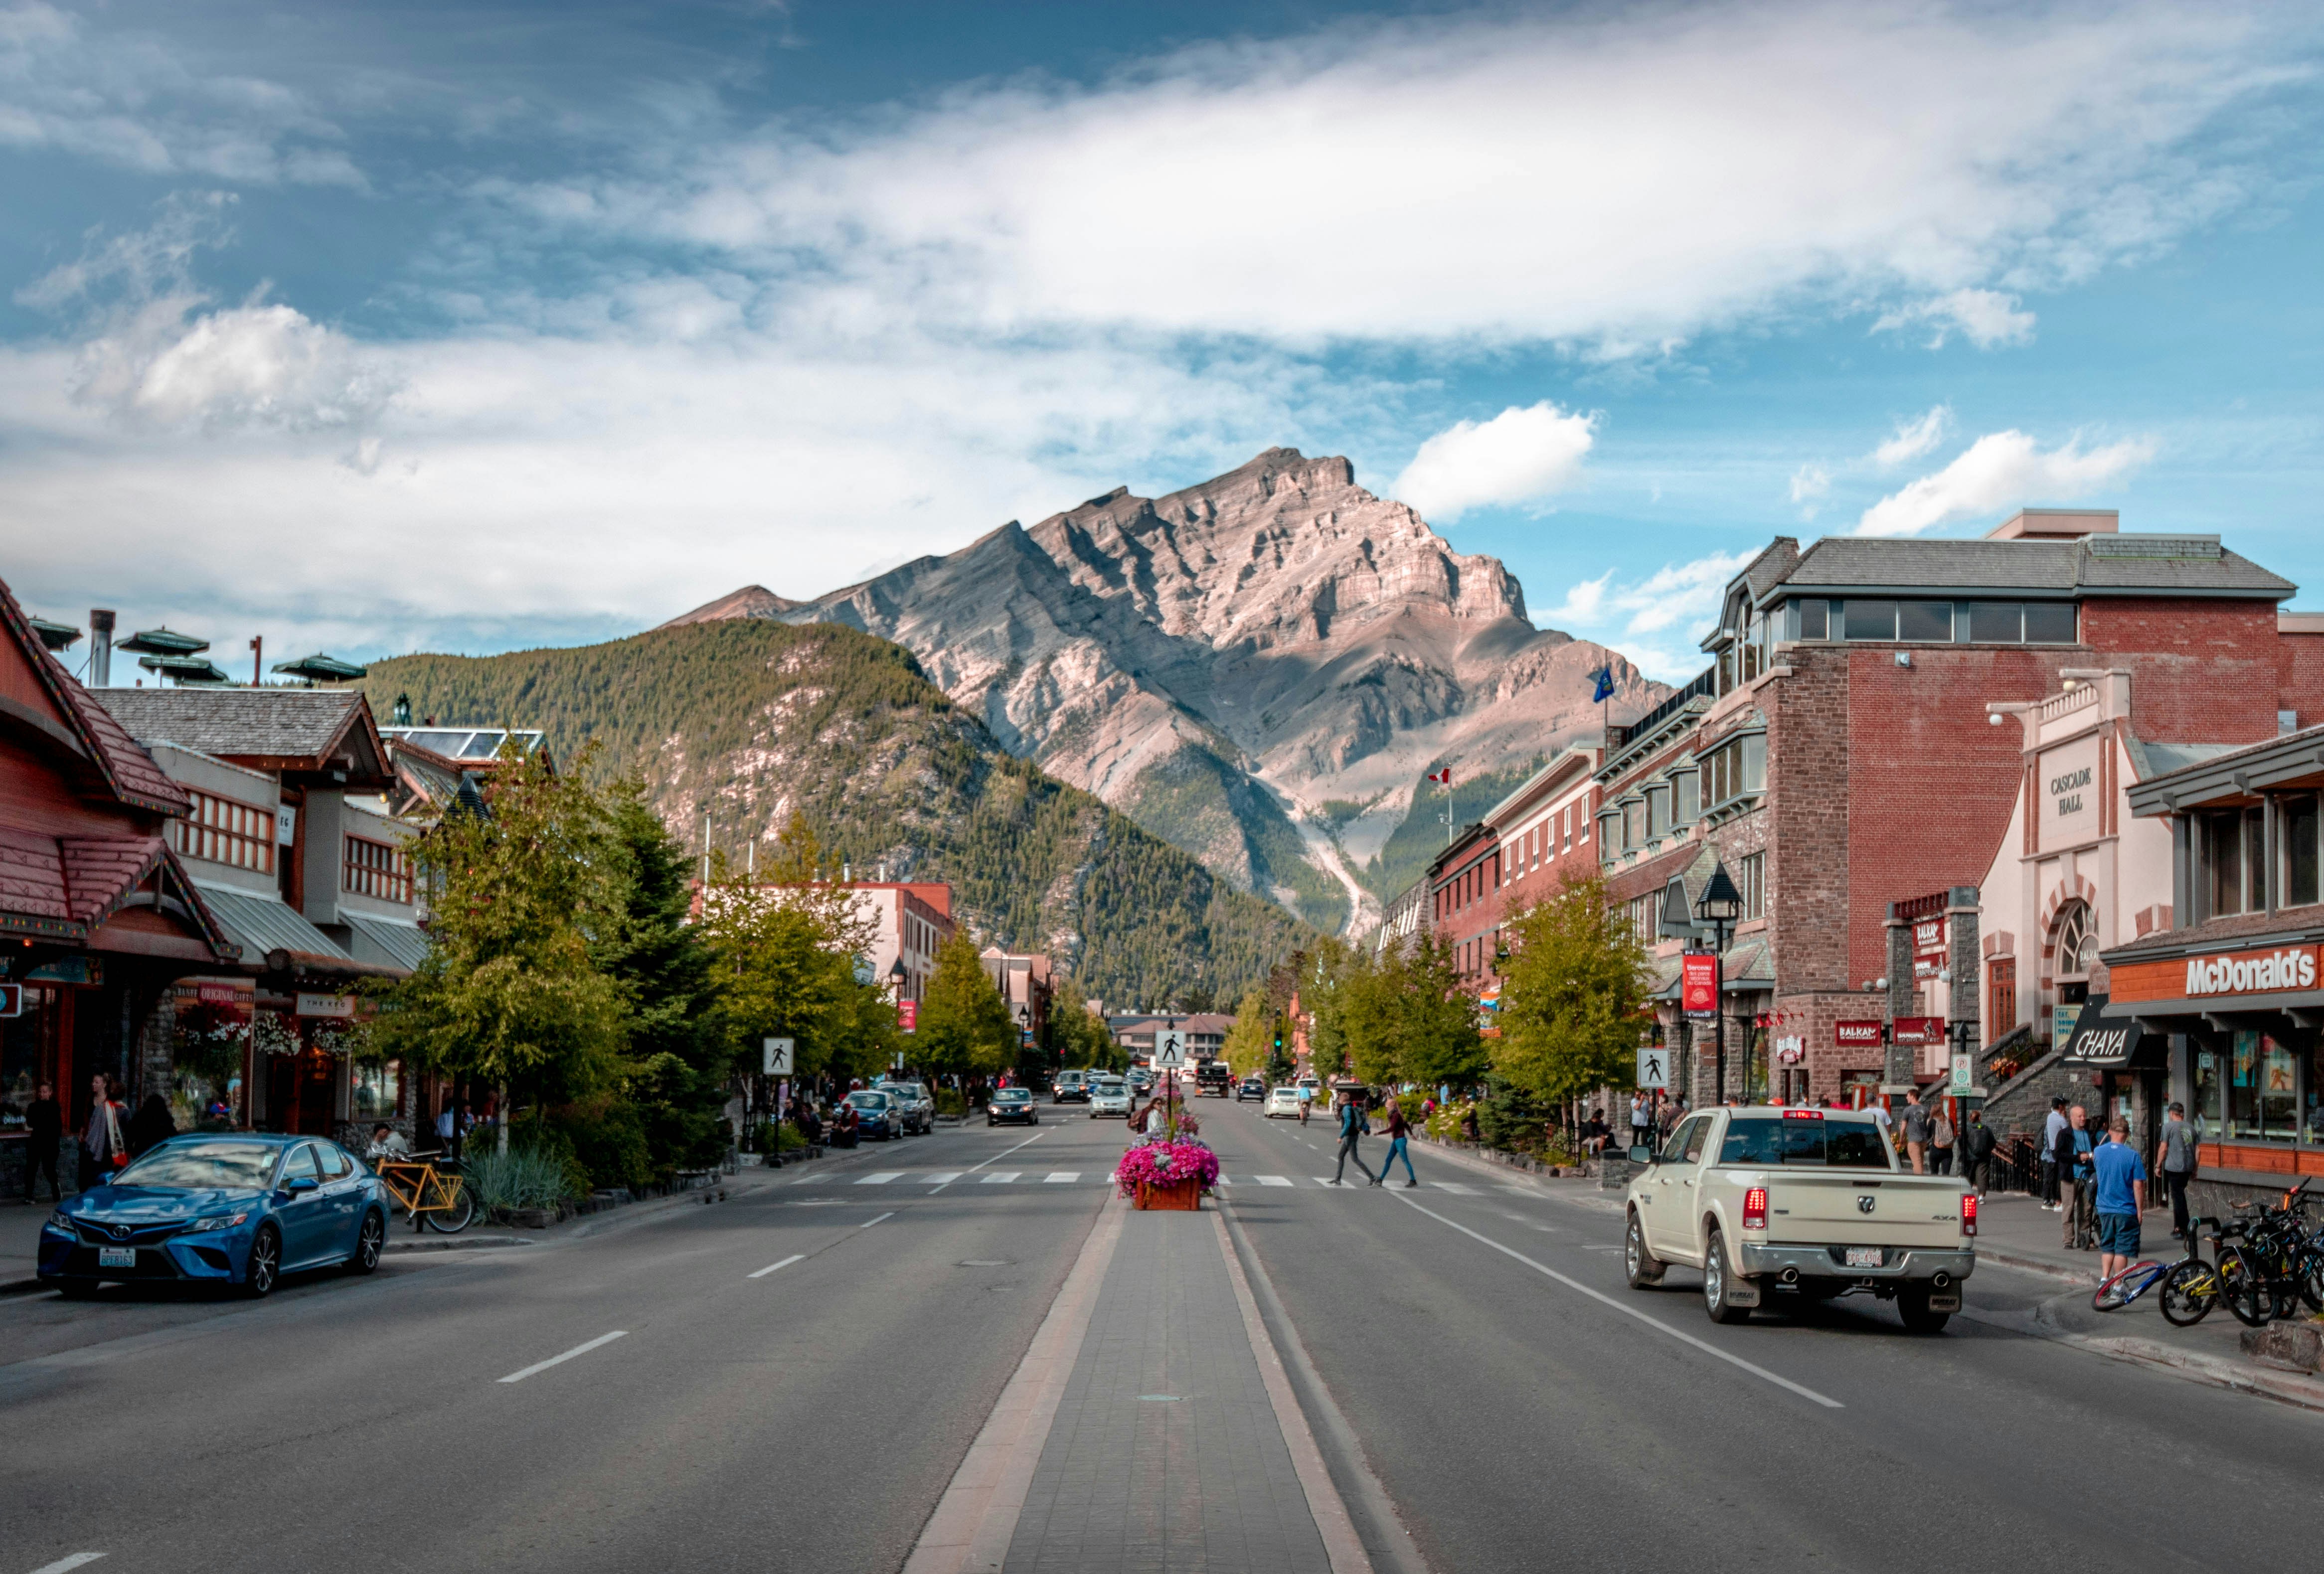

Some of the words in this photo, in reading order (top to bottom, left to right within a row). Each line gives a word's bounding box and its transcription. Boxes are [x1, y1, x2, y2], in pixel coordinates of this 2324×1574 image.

[2051, 768, 2091, 796] CASCADE
[2058, 794, 2083, 816] HALL
[280, 816, 289, 828] EG
[1917, 922, 1939, 941] BALKAN
[2186, 949, 2315, 995] McDonald's
[177, 987, 197, 997] BANFF
[201, 988, 234, 1001] ORIGINAL
[235, 993, 253, 1001] GIFTS
[1839, 1027, 1876, 1037] BALKAN
[2076, 1029, 2127, 1056] CHAYA
